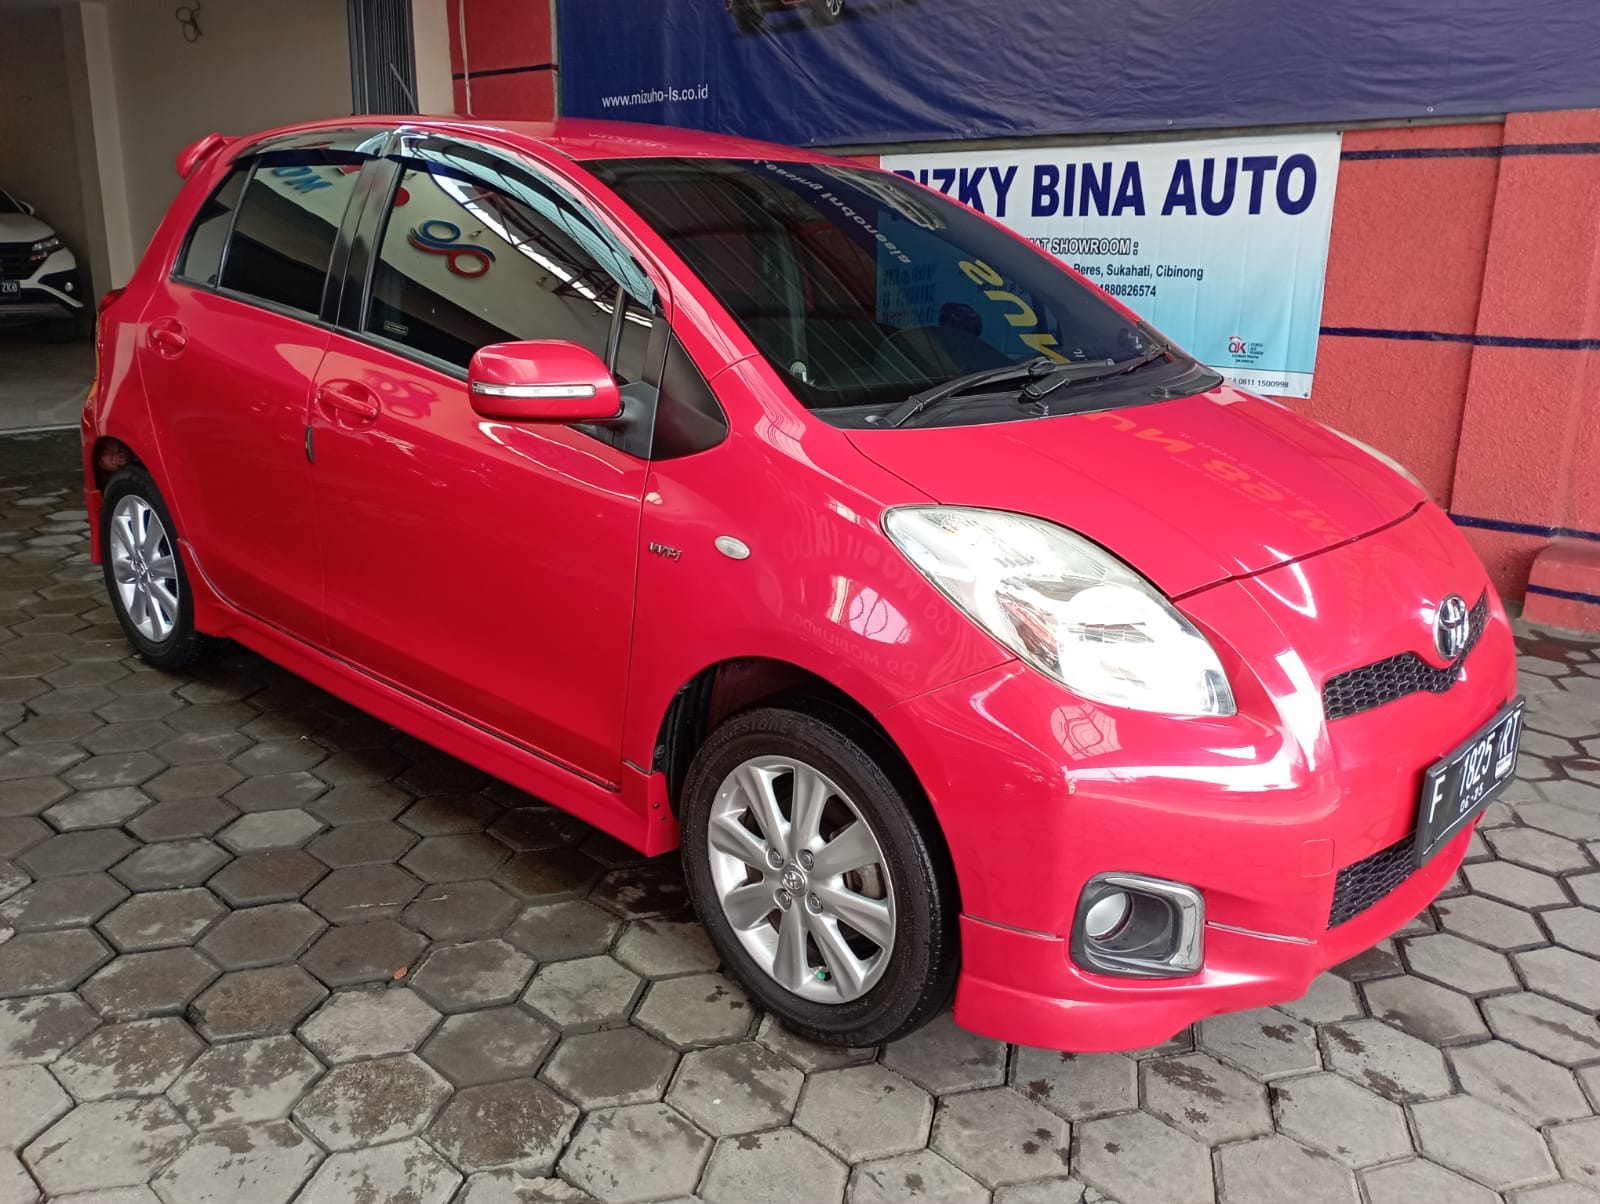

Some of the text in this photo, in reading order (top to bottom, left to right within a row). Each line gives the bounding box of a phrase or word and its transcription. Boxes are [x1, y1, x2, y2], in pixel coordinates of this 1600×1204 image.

[602, 84, 708, 107] www.mizuho-ls.co.id
[893, 153, 1317, 217] ZKY BINA AUTO
[1051, 237, 1131, 255] SHOWROOM
[1073, 263, 1204, 281] Beres, Sukahati, Cibinong
[1428, 774, 1446, 824] F
[1459, 732, 1496, 796] 1825
